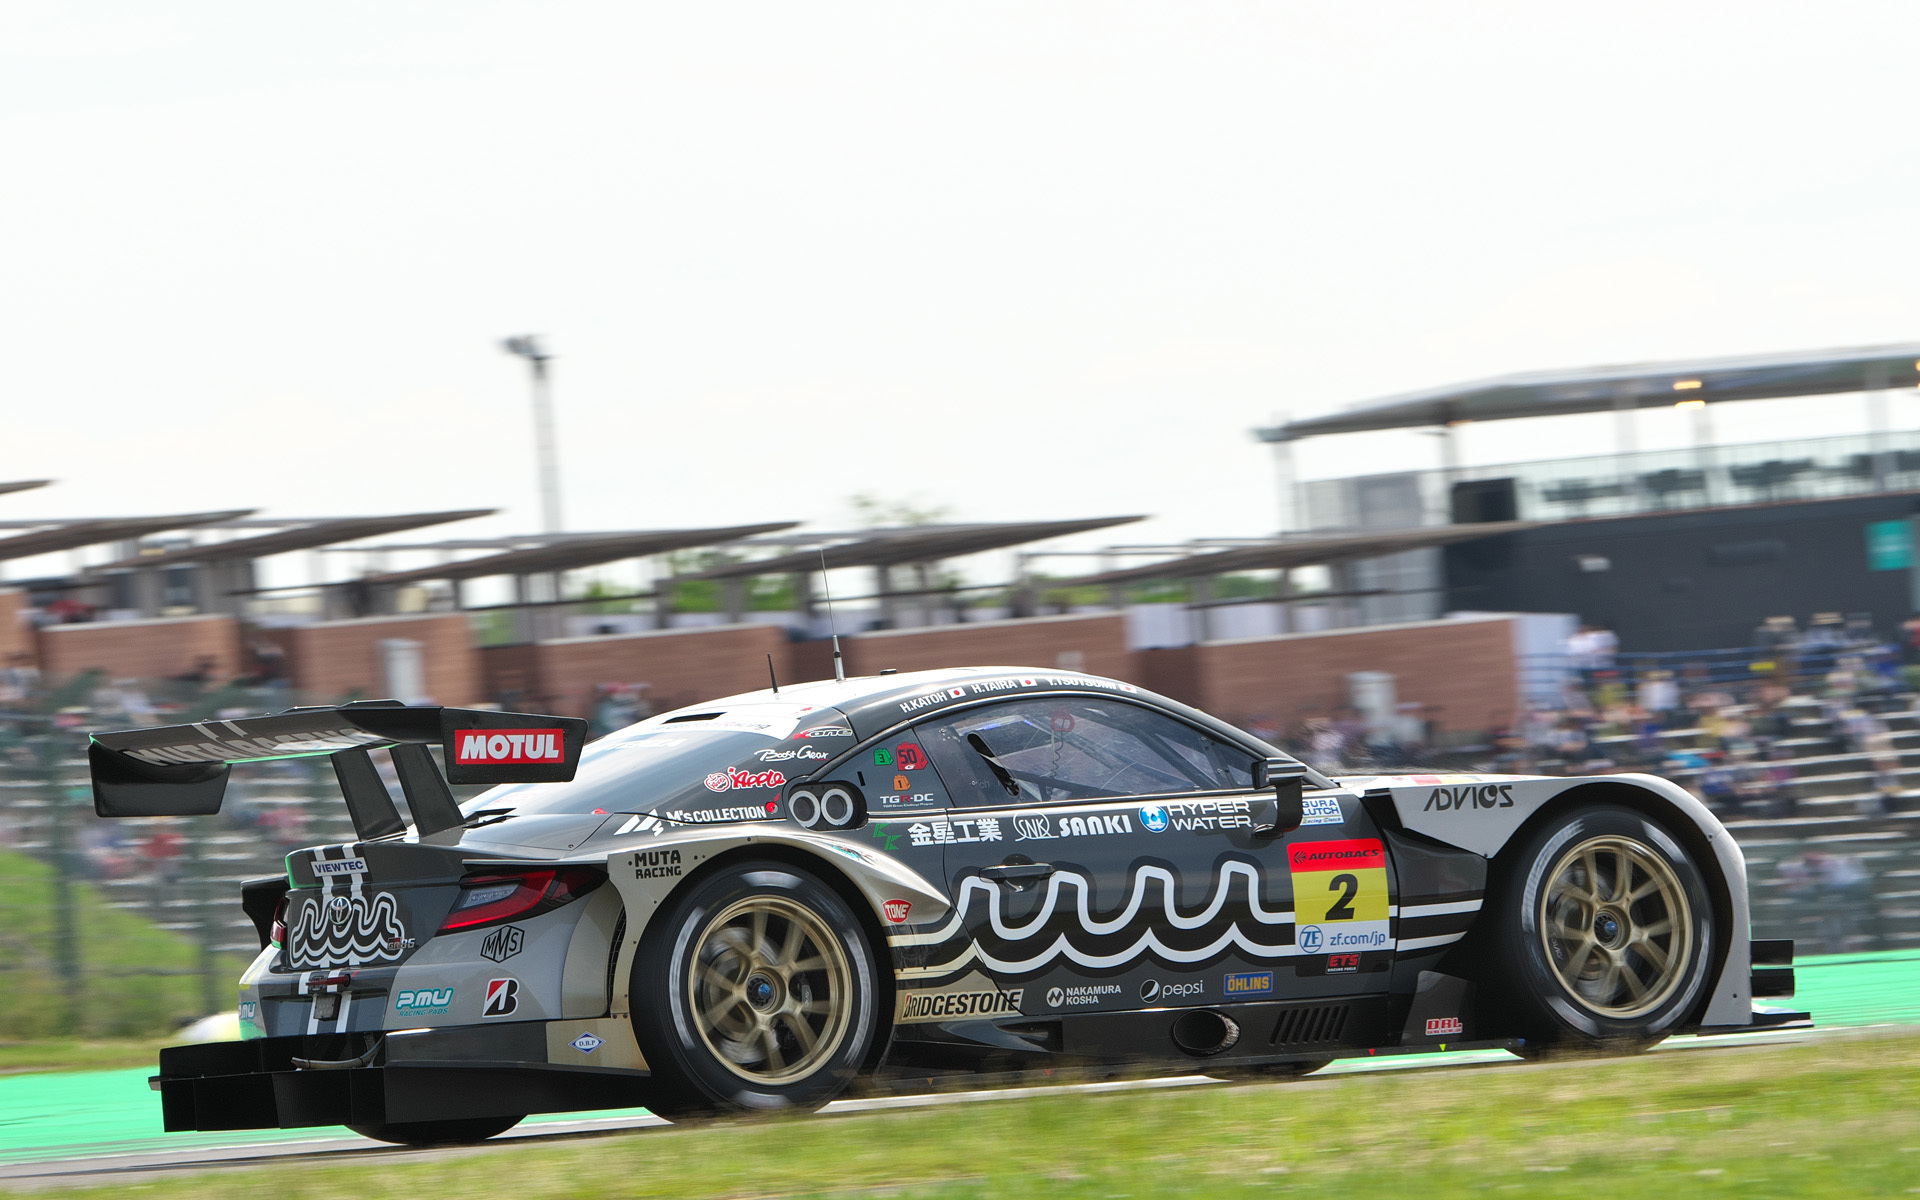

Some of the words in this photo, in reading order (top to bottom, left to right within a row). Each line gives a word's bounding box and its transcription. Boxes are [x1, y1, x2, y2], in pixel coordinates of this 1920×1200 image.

[971, 680, 1018, 694] H.TAIRA
[900, 692, 948, 713] H.KATOH
[460, 734, 559, 760] MOTUL
[754, 748, 796, 762] Boost
[797, 745, 829, 760] Gear
[878, 754, 885, 763] 3
[897, 749, 918, 764] 50
[880, 793, 934, 804] TGR-DC
[1302, 799, 1337, 808] GURA
[1423, 785, 1514, 811] ADVICS
[694, 806, 767, 822] COLLECTION
[1167, 801, 1250, 816] HYPER
[1302, 807, 1339, 815] LUTCH
[1059, 815, 1133, 838] SANKI
[1171, 816, 1252, 831] WATER
[908, 818, 1003, 847] 金星工業
[634, 850, 681, 867] MUTA
[1308, 849, 1379, 860] AUTOBACS
[315, 861, 364, 873] VIEWTEC
[635, 866, 682, 879] RACING
[1325, 873, 1358, 921] 2
[885, 904, 908, 919] TONE
[1302, 931, 1321, 948] ZF
[1330, 931, 1386, 946] zf.com/jp
[1328, 954, 1359, 968] ETS
[1066, 984, 1122, 996] NAKAMURA
[1162, 980, 1204, 999] pepsi
[1228, 975, 1270, 992] ÖHLINS
[903, 991, 1022, 1018] BRIDGESTONE
[1066, 994, 1099, 1005] KOSHA
[399, 1009, 426, 1017] RACING
[428, 1007, 448, 1015] PADS
[1427, 1018, 1462, 1029] DRL
